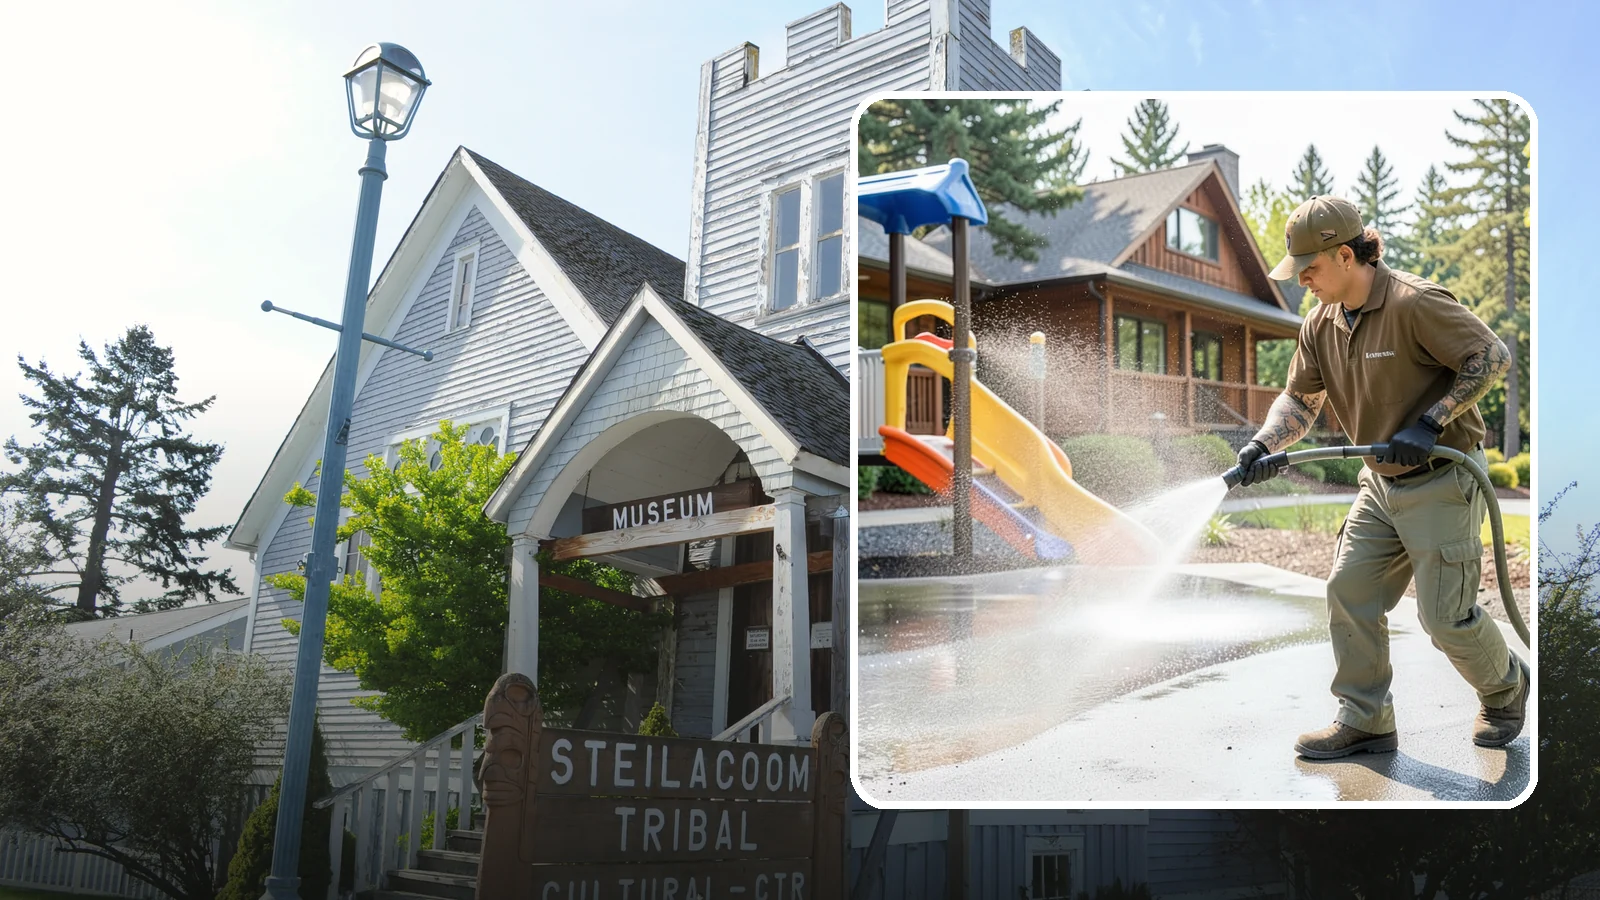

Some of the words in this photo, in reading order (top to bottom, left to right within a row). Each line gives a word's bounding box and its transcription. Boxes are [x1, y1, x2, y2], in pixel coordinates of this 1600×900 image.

[612, 491, 714, 530] MUSEUM
[550, 738, 810, 793] STEILACOOM
[614, 806, 758, 852] TRIBAL
